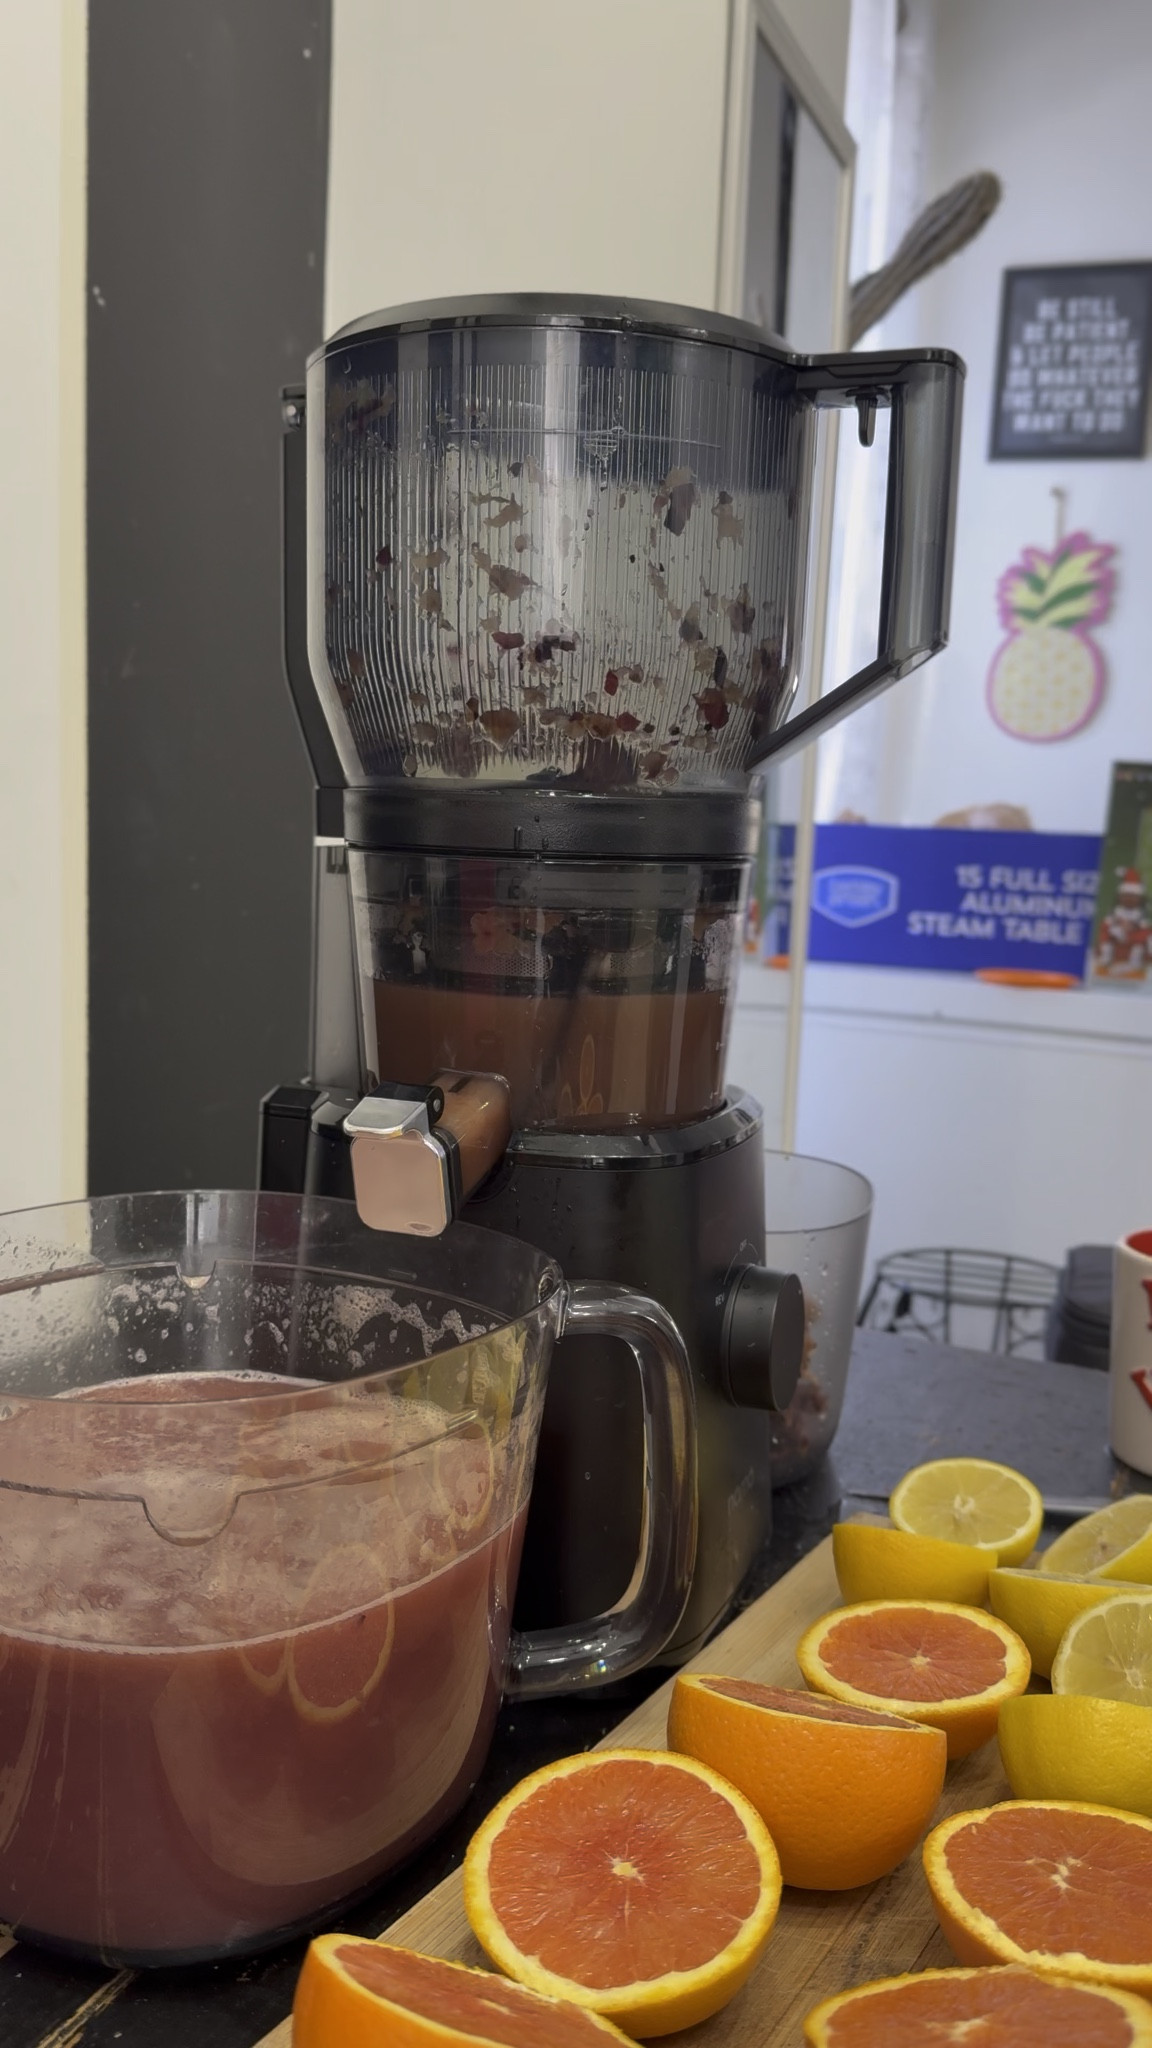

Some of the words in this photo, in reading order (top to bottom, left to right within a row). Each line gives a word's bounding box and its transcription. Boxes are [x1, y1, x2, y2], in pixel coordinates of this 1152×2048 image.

[1037, 299, 1060, 319] BE
[1023, 322, 1045, 343] BE
[1052, 318, 1130, 341] PATIENT
[1067, 340, 1139, 366] PEOPLE
[1093, 387, 1140, 409] THEY
[955, 864, 983, 889] 15
[988, 866, 1055, 893] FULL
[960, 892, 1095, 919] ALUMINU
[906, 910, 995, 939] STEAM
[1002, 918, 1083, 946] TABLE
